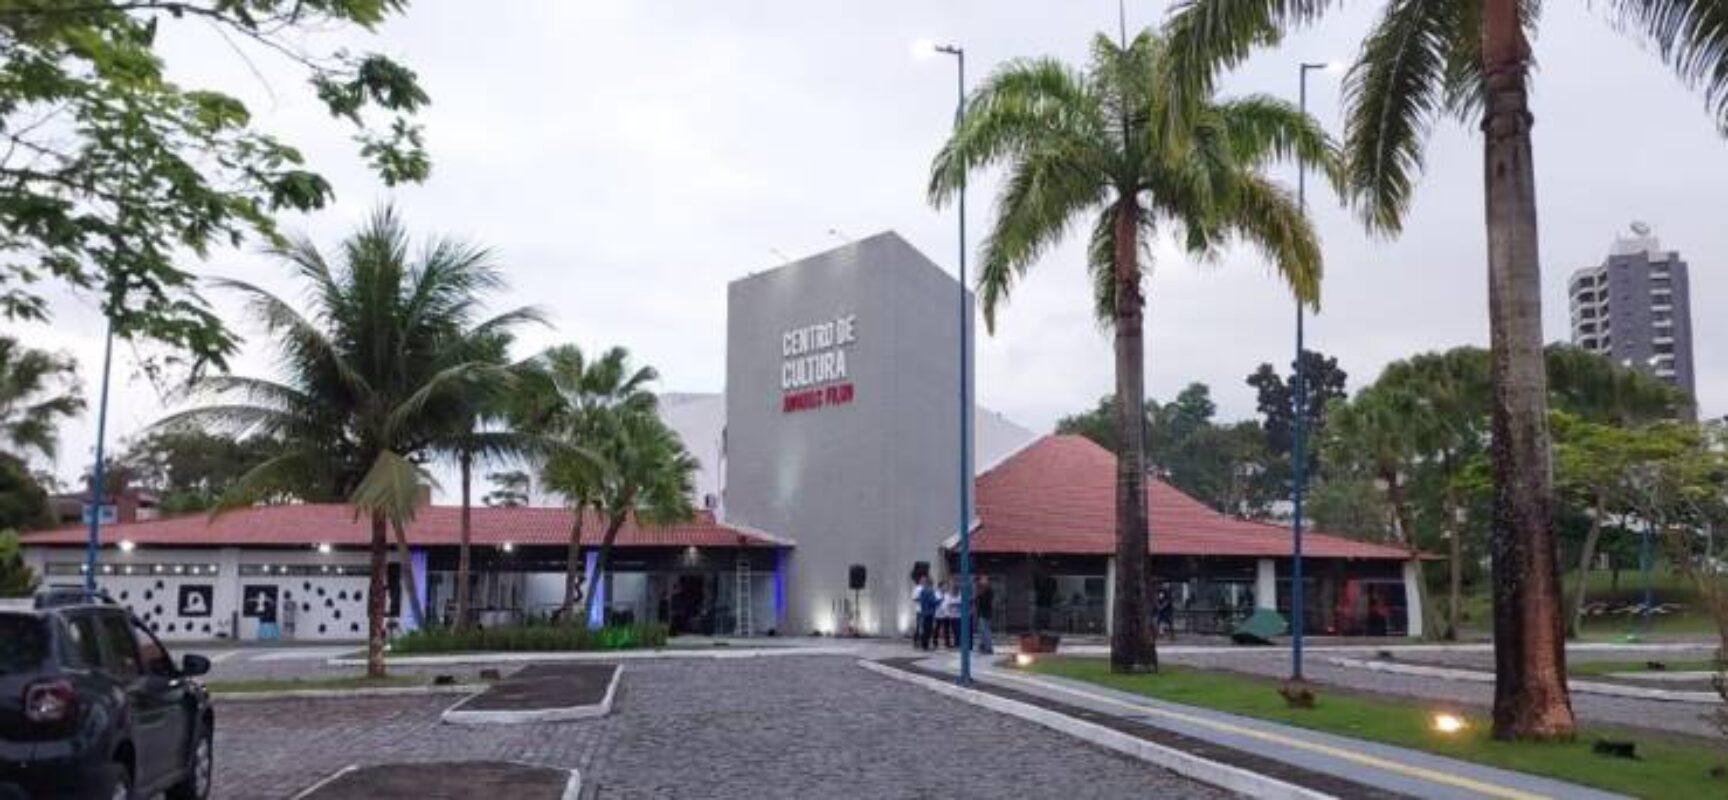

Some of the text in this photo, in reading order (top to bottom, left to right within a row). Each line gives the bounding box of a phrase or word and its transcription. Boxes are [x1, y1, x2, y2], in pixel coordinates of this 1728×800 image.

[783, 315, 856, 356] CENTRO DE
[782, 349, 846, 388] CULTURA
